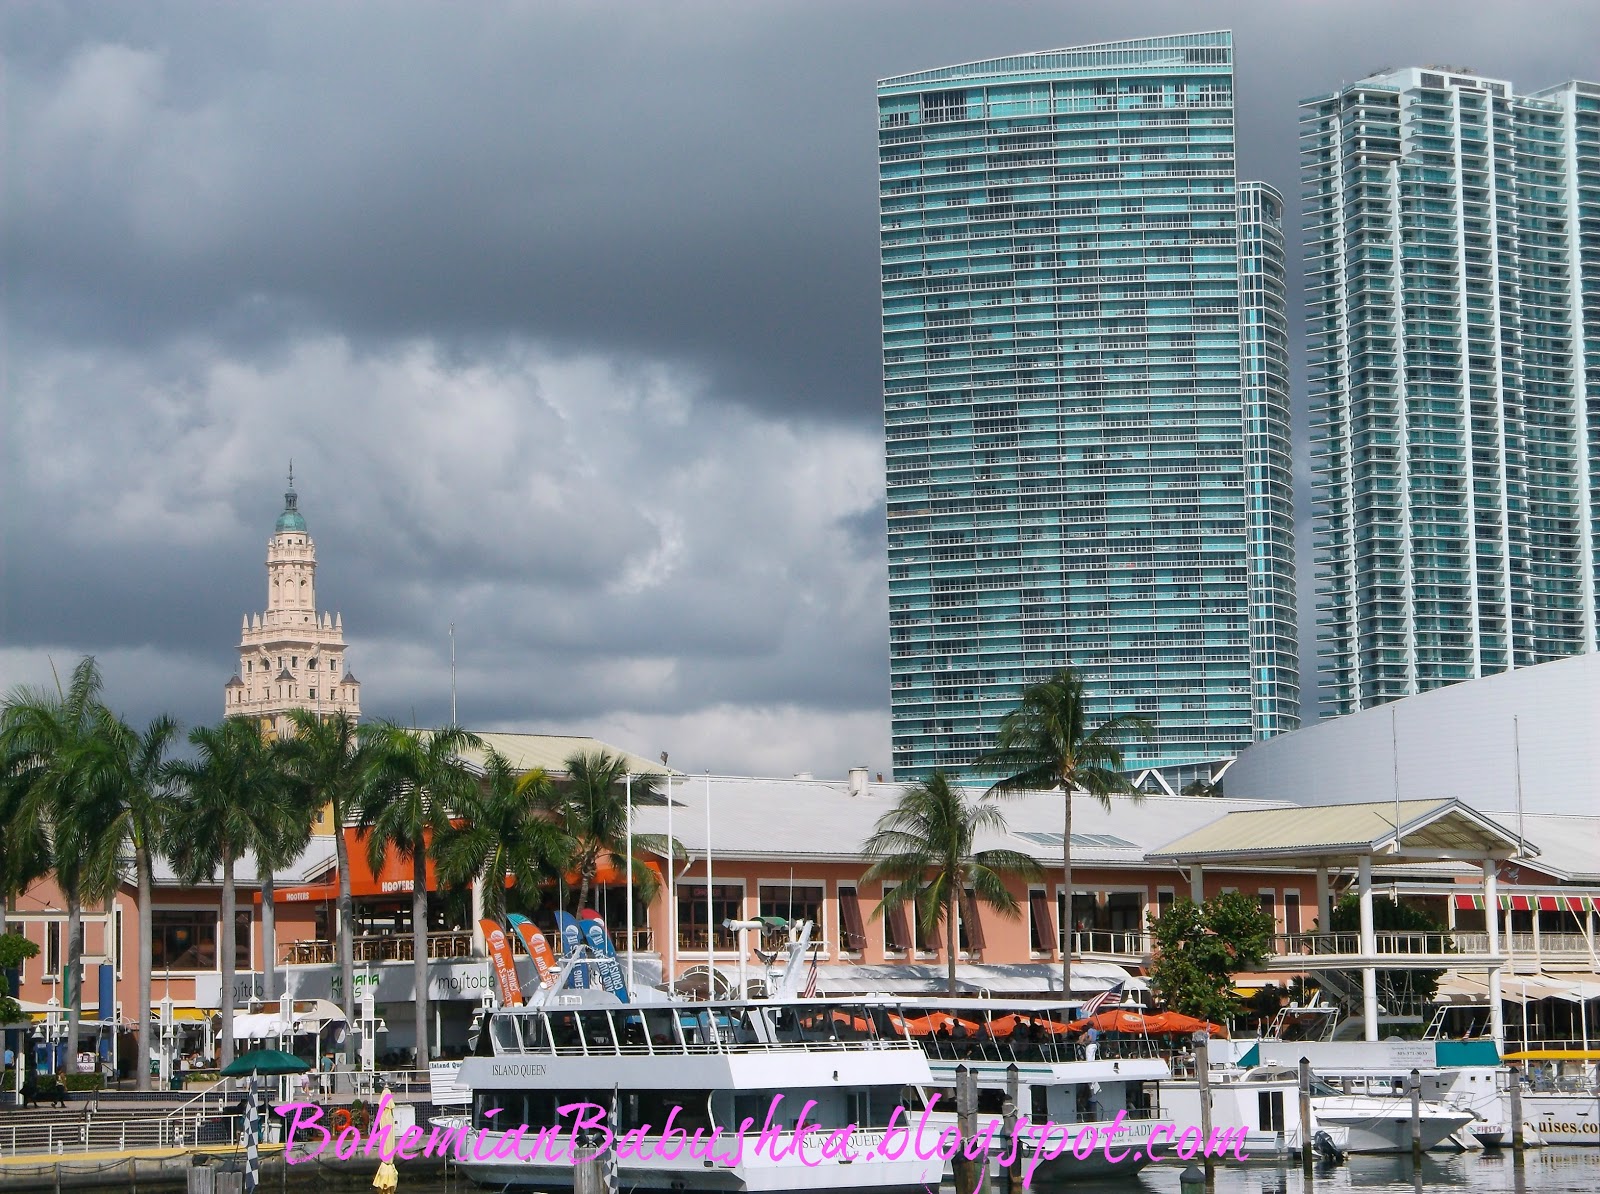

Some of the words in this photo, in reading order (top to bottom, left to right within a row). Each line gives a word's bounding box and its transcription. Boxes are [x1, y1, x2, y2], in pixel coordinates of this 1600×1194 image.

[382, 880, 414, 892] HOOTERS
[286, 892, 310, 901] HOOTERS
[492, 1065, 520, 1076] ISLAND
[521, 1064, 547, 1078] QUEEN
[1128, 1124, 1153, 1137] LADY
[1477, 1125, 1502, 1134] FIESTA
